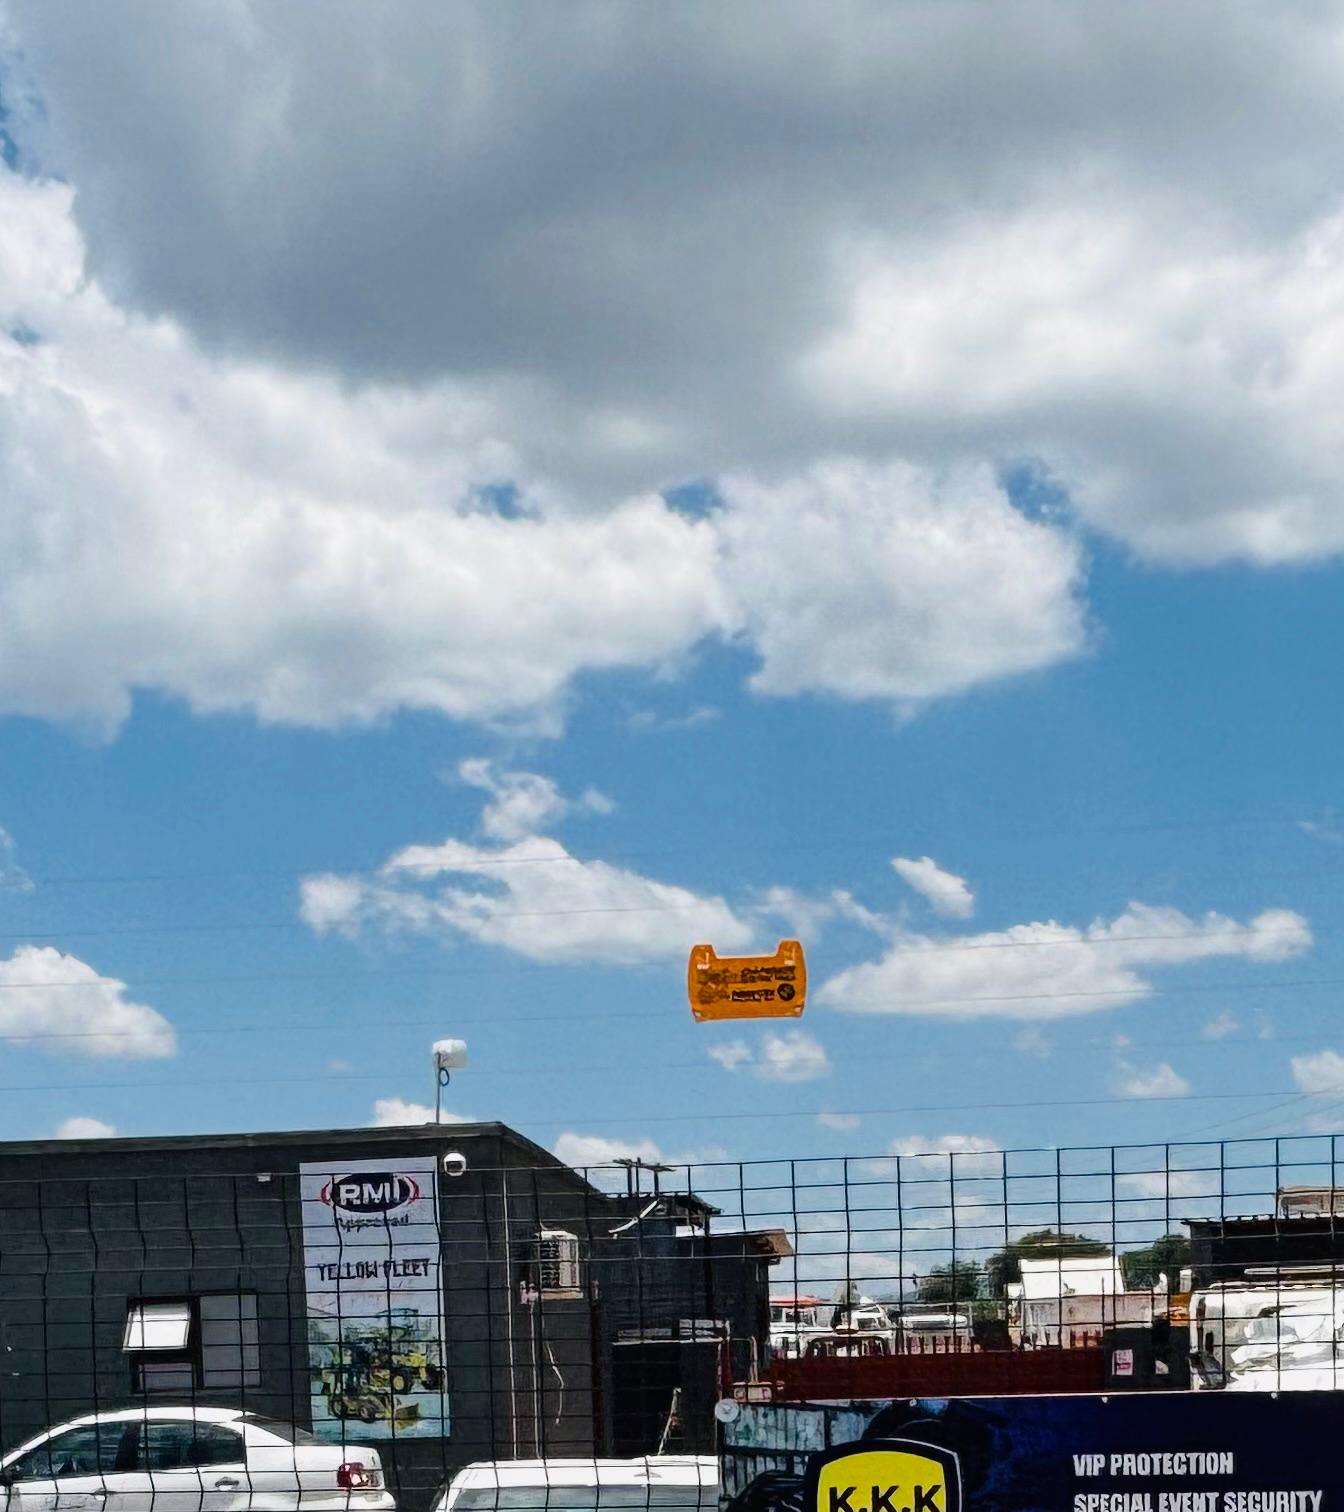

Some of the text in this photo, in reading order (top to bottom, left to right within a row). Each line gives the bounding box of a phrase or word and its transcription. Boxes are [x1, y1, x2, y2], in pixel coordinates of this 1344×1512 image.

[339, 1180, 401, 1206] RMI
[318, 1260, 378, 1281] YELLOW
[1072, 1452, 1234, 1476] VIP PROTECTION
